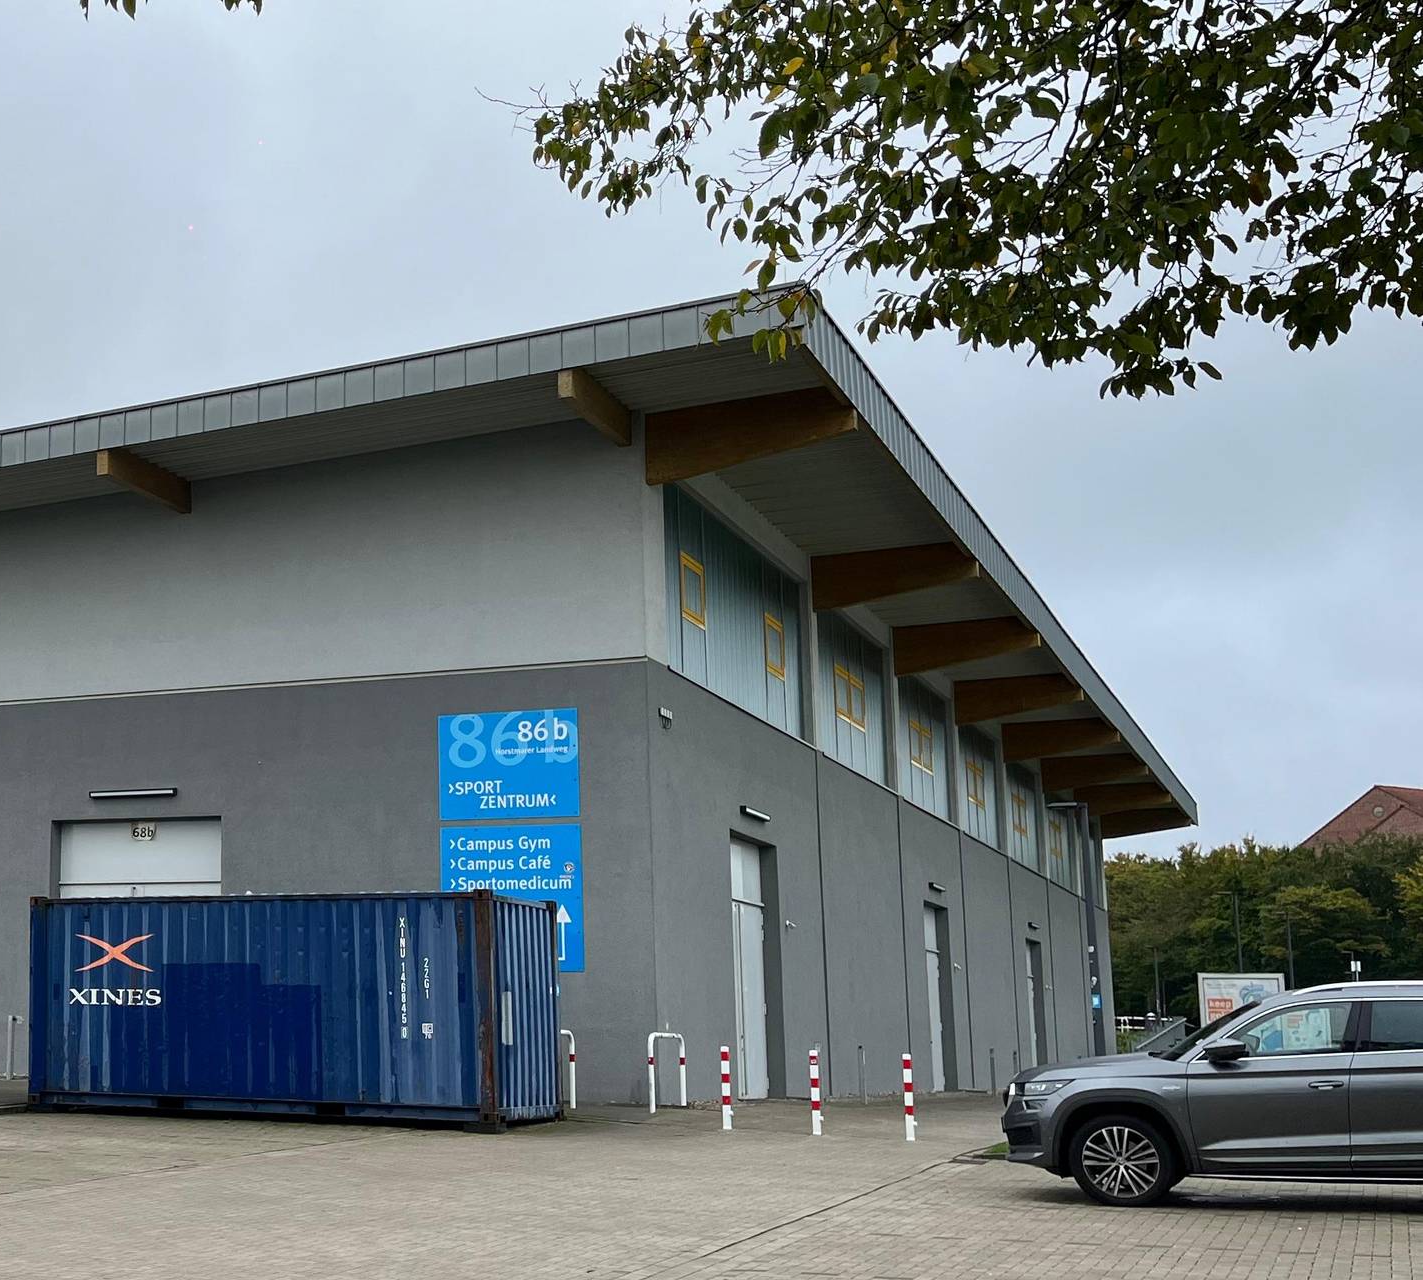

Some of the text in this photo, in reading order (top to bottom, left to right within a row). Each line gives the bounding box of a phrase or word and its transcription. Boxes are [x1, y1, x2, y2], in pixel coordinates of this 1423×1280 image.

[536, 745, 568, 754] Landweg
[133, 825, 154, 838] 68b
[518, 836, 551, 853] Gym
[519, 855, 551, 869] Café
[69, 988, 162, 1006] XINES
